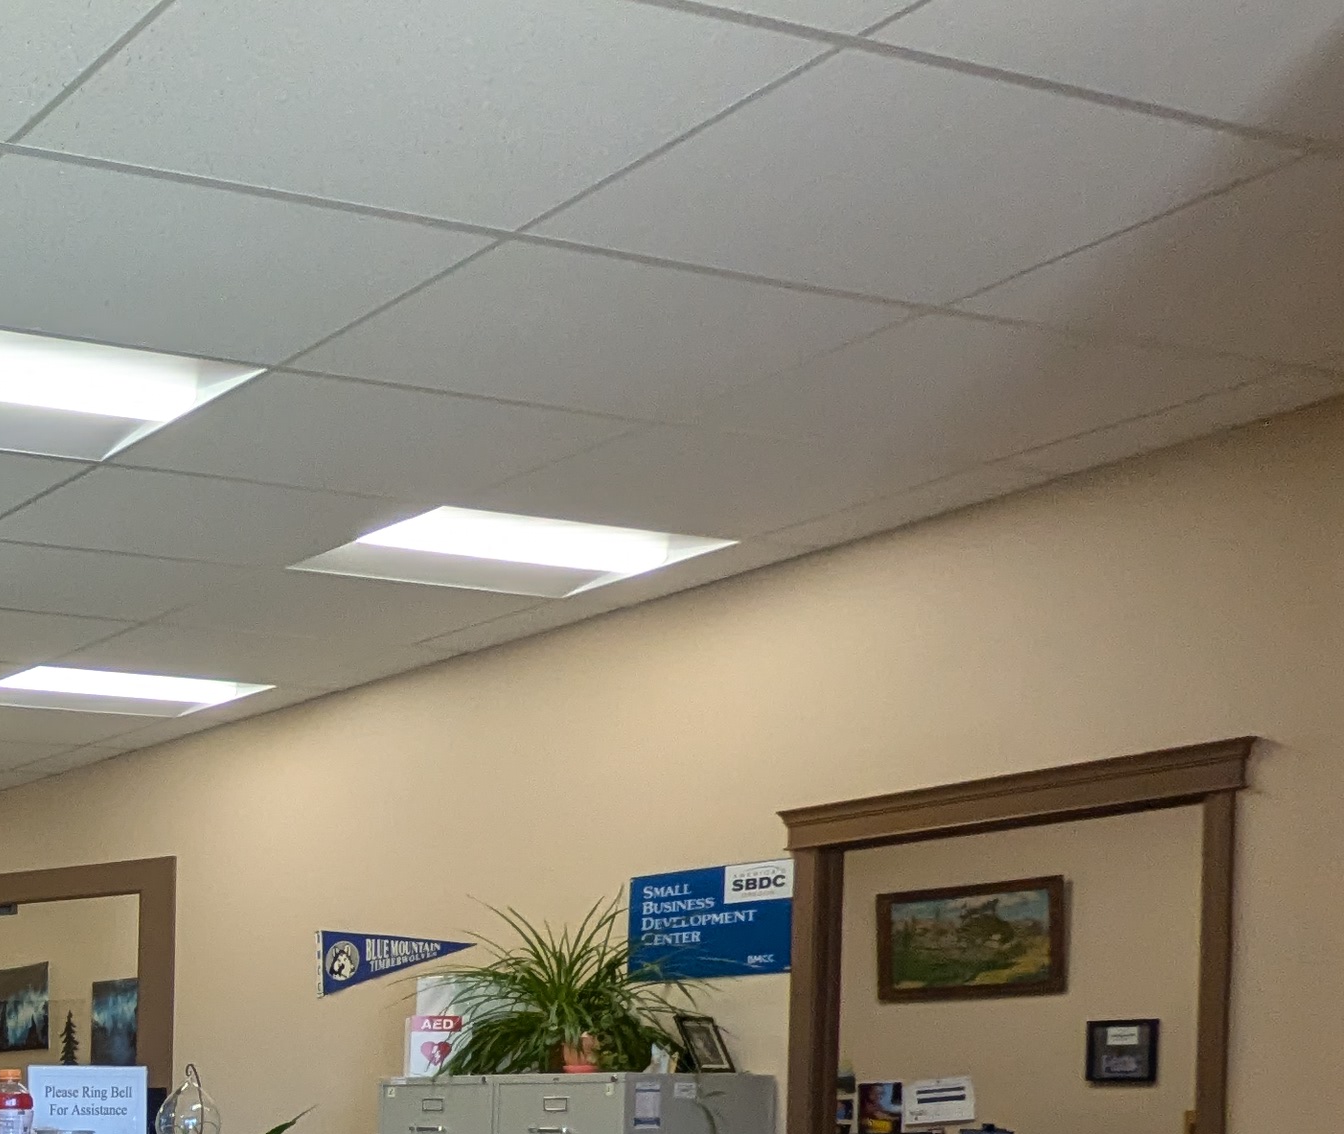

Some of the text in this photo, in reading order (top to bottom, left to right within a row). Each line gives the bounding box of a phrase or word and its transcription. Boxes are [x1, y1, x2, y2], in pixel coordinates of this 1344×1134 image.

[643, 883, 692, 899] SMALL
[732, 874, 786, 892] SBDC
[642, 897, 715, 915] BUSINESS
[641, 909, 758, 931] DEVELOPMENT
[642, 931, 701, 946] CENTER
[365, 938, 441, 962] BLUE MOUNTAIN
[369, 951, 438, 972] TIMBERWOLVES
[747, 954, 775, 964] BMCC
[420, 1018, 454, 1030] AED
[45, 1085, 133, 1100] Please Ring Bell
[50, 1103, 127, 1115] For Assistance
